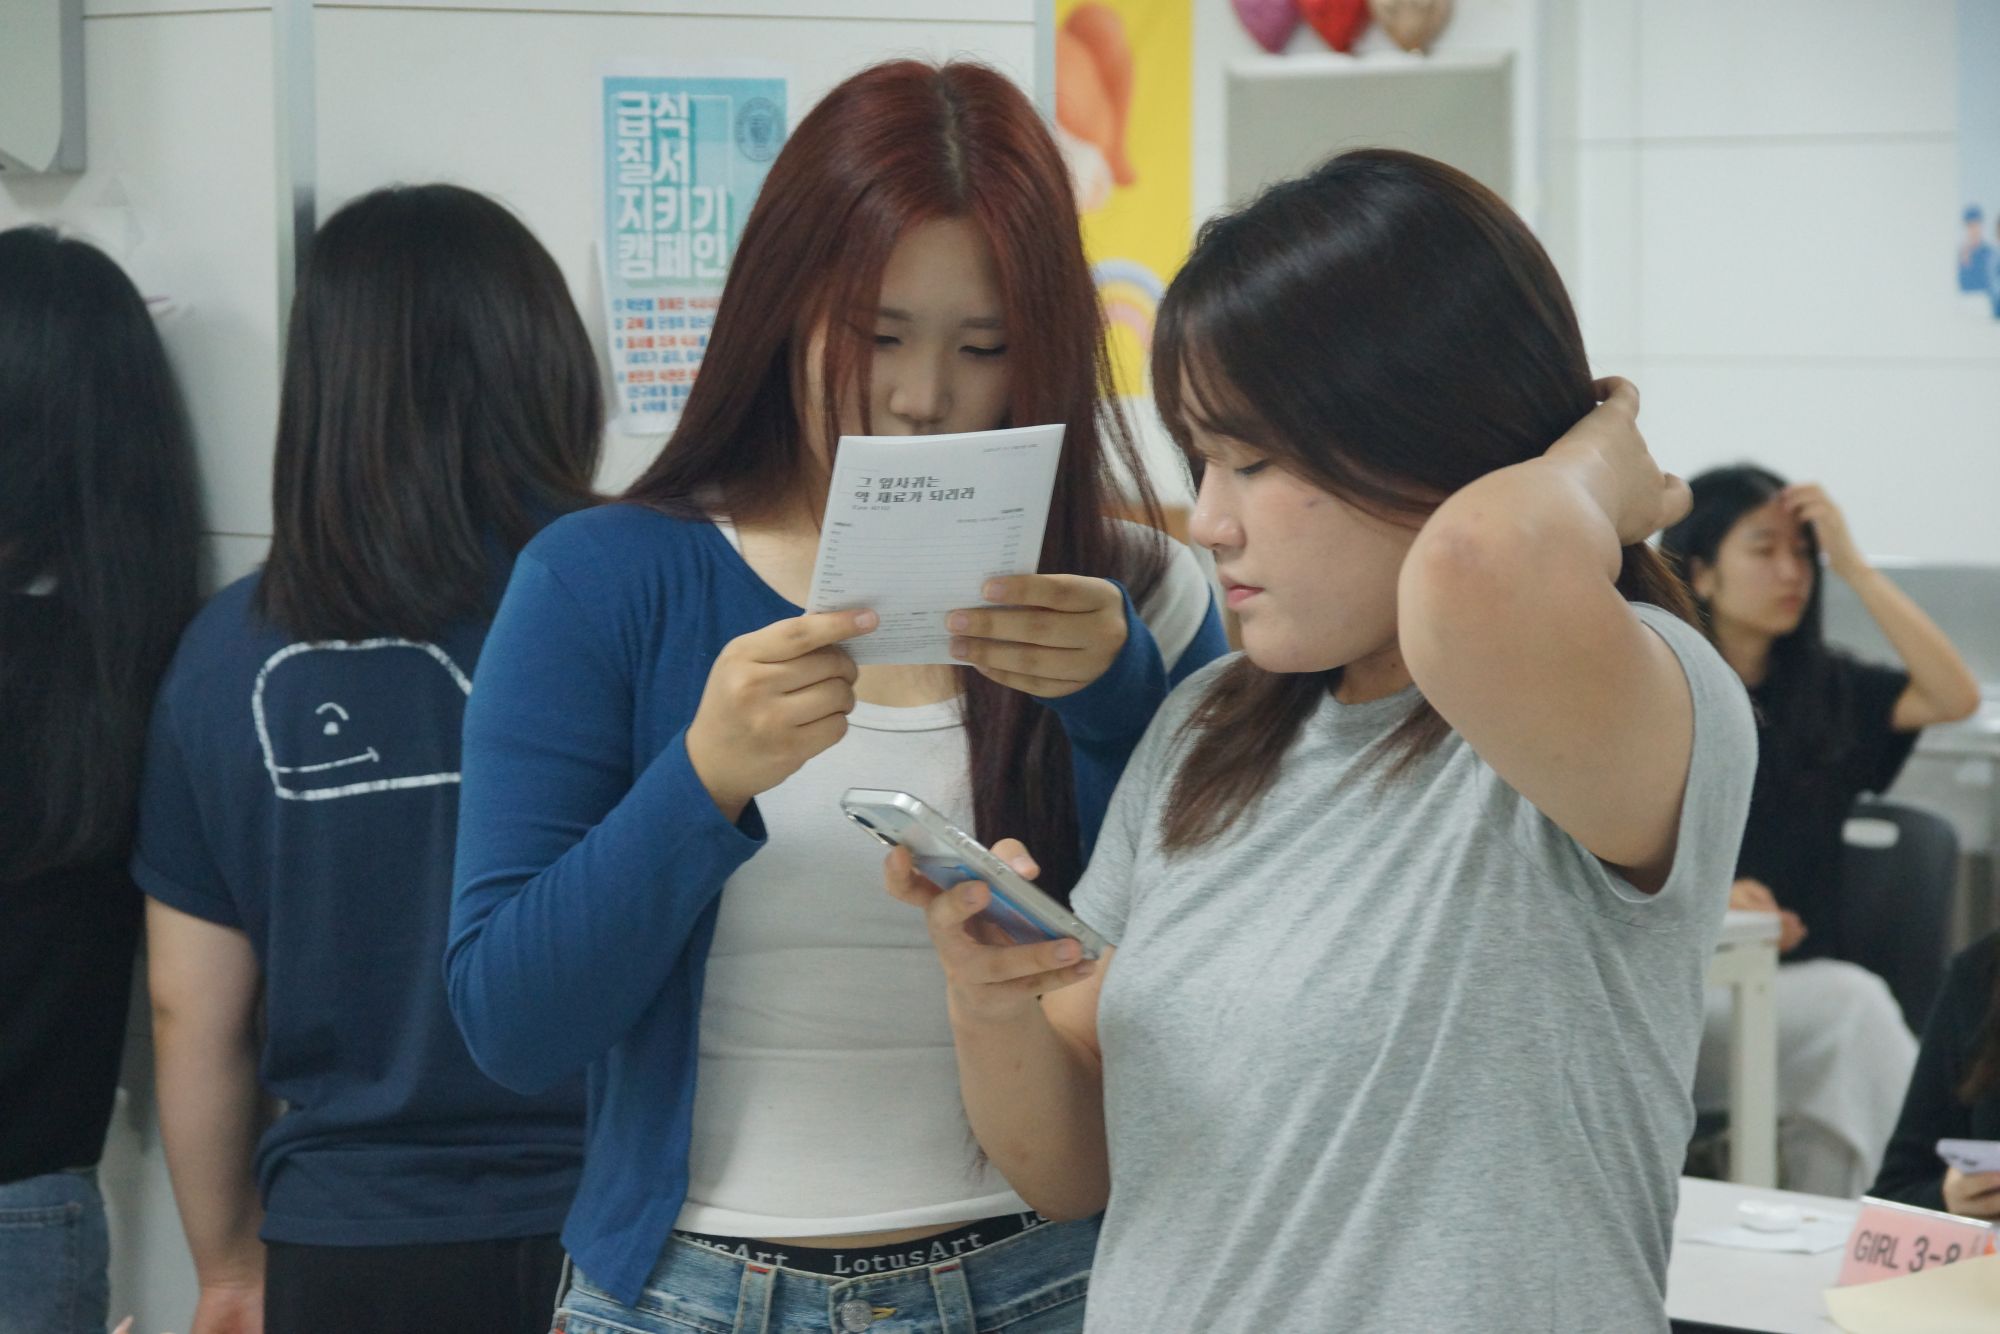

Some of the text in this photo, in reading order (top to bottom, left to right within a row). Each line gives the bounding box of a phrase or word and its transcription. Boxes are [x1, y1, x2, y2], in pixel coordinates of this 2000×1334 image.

[616, 91, 690, 138] 급식
[616, 139, 690, 185] 질서
[616, 184, 728, 232] 지키기
[616, 232, 728, 279] 캠페인
[854, 491, 870, 504] 약
[877, 490, 923, 504] 재료가
[856, 477, 873, 488] 그
[832, 1232, 984, 1275] LotusArt
[1854, 1229, 1900, 1271] GIRL
